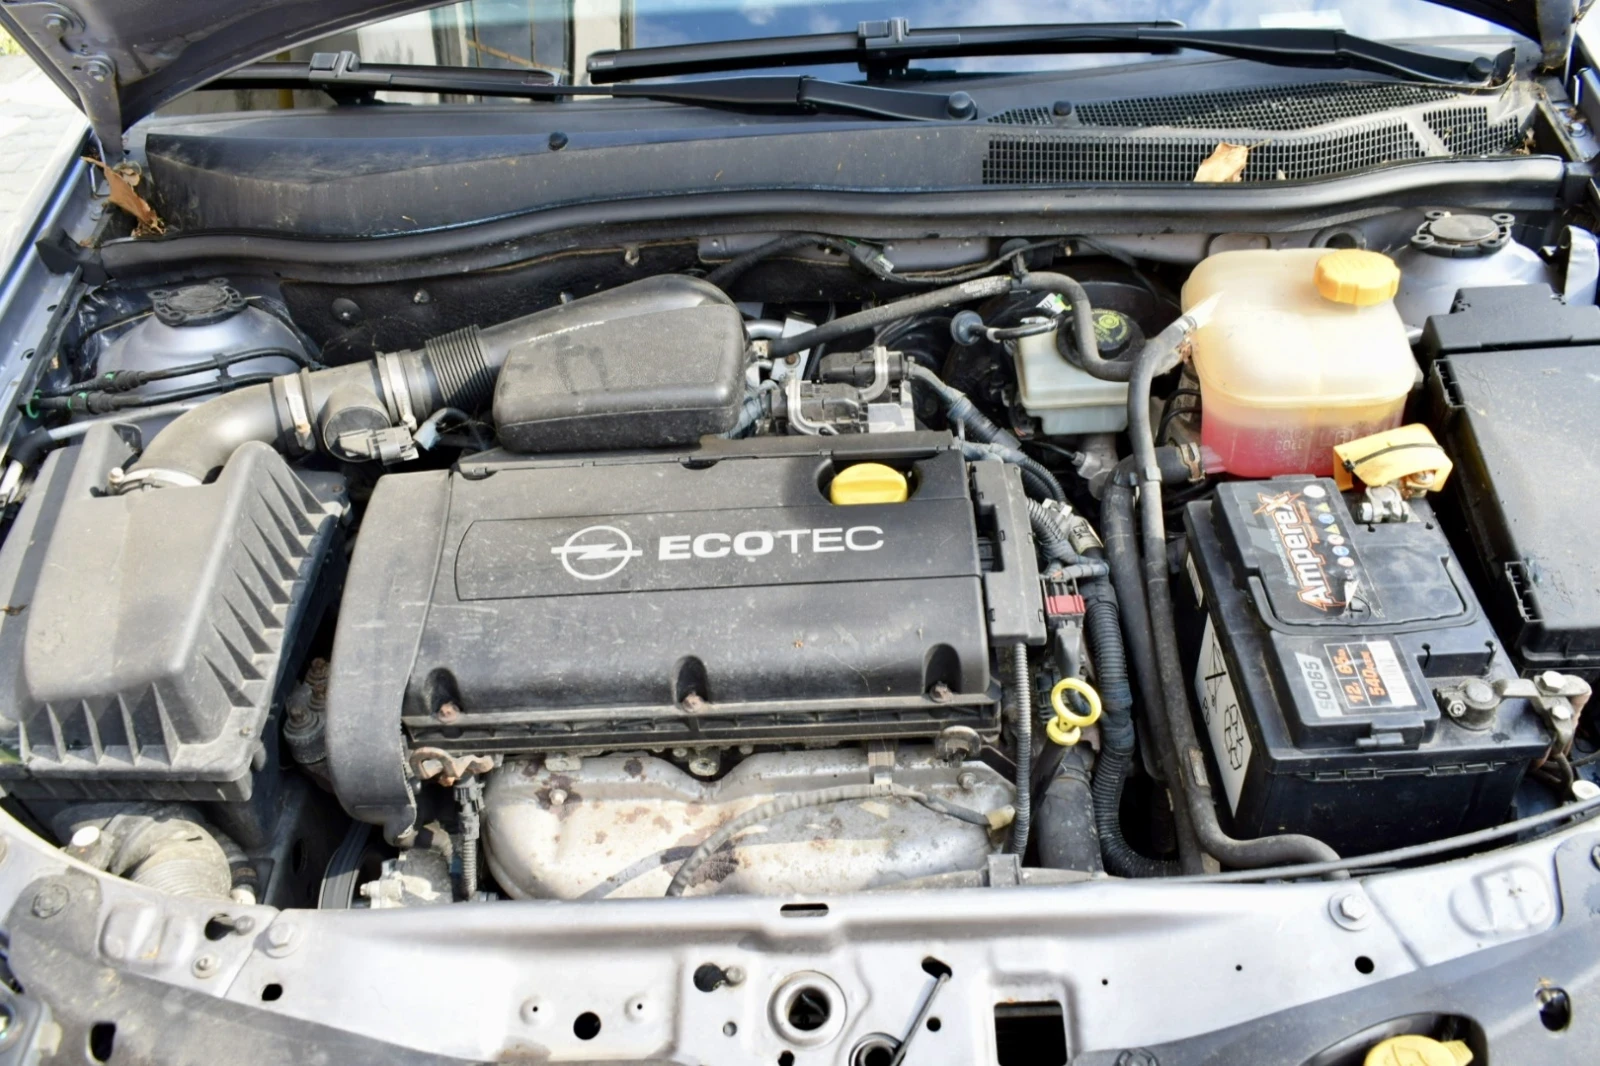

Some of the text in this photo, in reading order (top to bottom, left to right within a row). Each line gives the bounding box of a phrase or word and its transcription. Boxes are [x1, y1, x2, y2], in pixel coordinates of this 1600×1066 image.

[658, 525, 884, 561] ECOTEC
[1257, 491, 1335, 609] AmpereX
[1303, 660, 1335, 711] S0065
